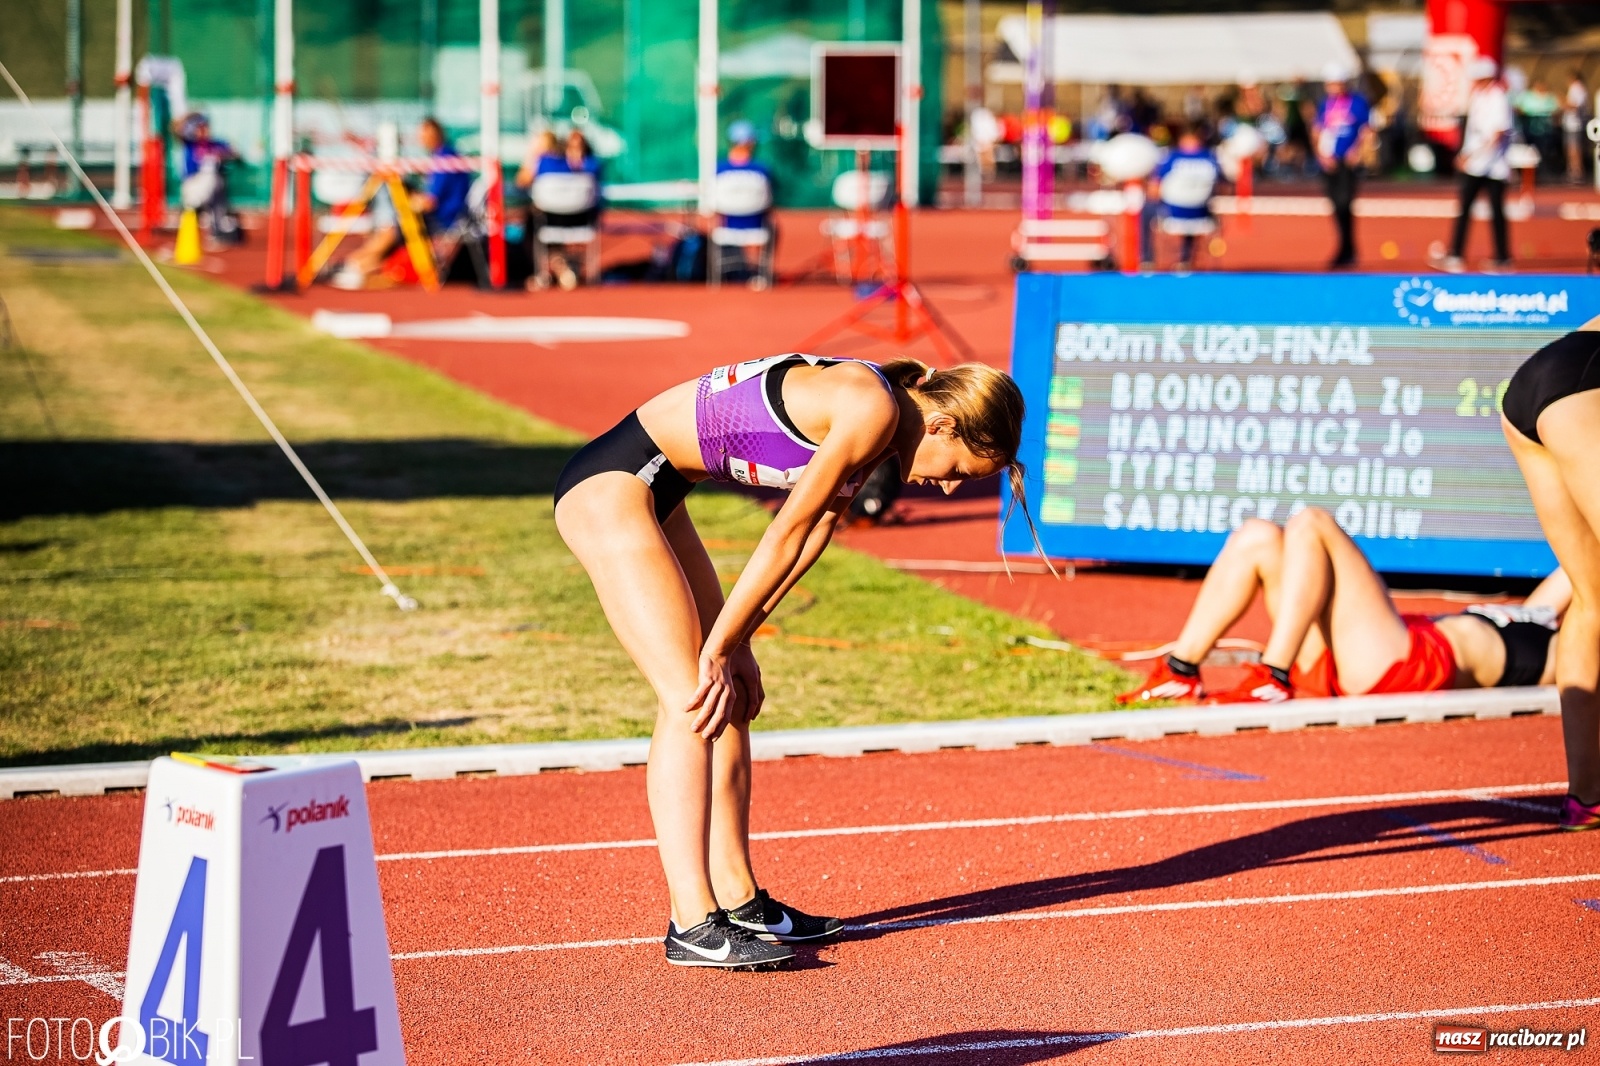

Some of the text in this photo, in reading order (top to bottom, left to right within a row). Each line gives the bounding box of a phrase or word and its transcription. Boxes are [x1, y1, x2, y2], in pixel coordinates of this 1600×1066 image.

[1161, 324, 1188, 362] K
[1110, 372, 1357, 414] BRONOWSKA
[1379, 376, 1424, 416] Zu
[1108, 412, 1424, 457] HAPUNOWICZ Jo
[1106, 450, 1433, 498] TYPER Michalina
[1335, 498, 1422, 540] Oliw
[176, 804, 217, 831] polanik
[286, 795, 350, 833] polanik
[140, 856, 209, 1066] 4
[260, 843, 378, 1066] 4
